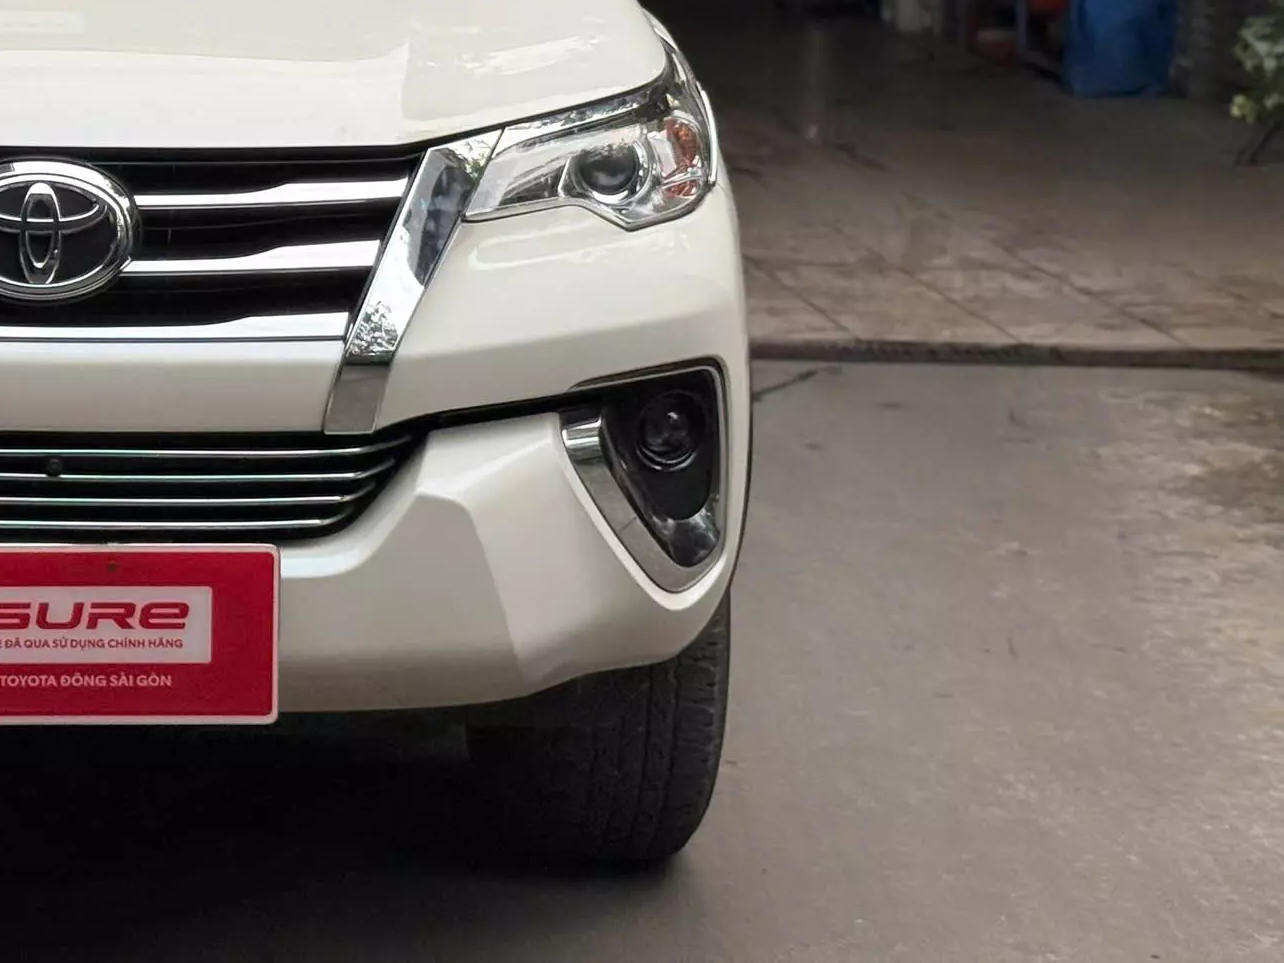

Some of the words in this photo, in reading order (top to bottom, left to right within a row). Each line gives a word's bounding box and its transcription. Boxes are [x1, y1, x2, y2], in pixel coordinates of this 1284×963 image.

[23, 638, 50, 650] QUA
[69, 638, 105, 652] DỤNG
[107, 636, 145, 649] CHÍNH
[59, 672, 107, 687] ĐÔNG
[109, 671, 134, 687] SÀI
[136, 672, 172, 687] GÒN
